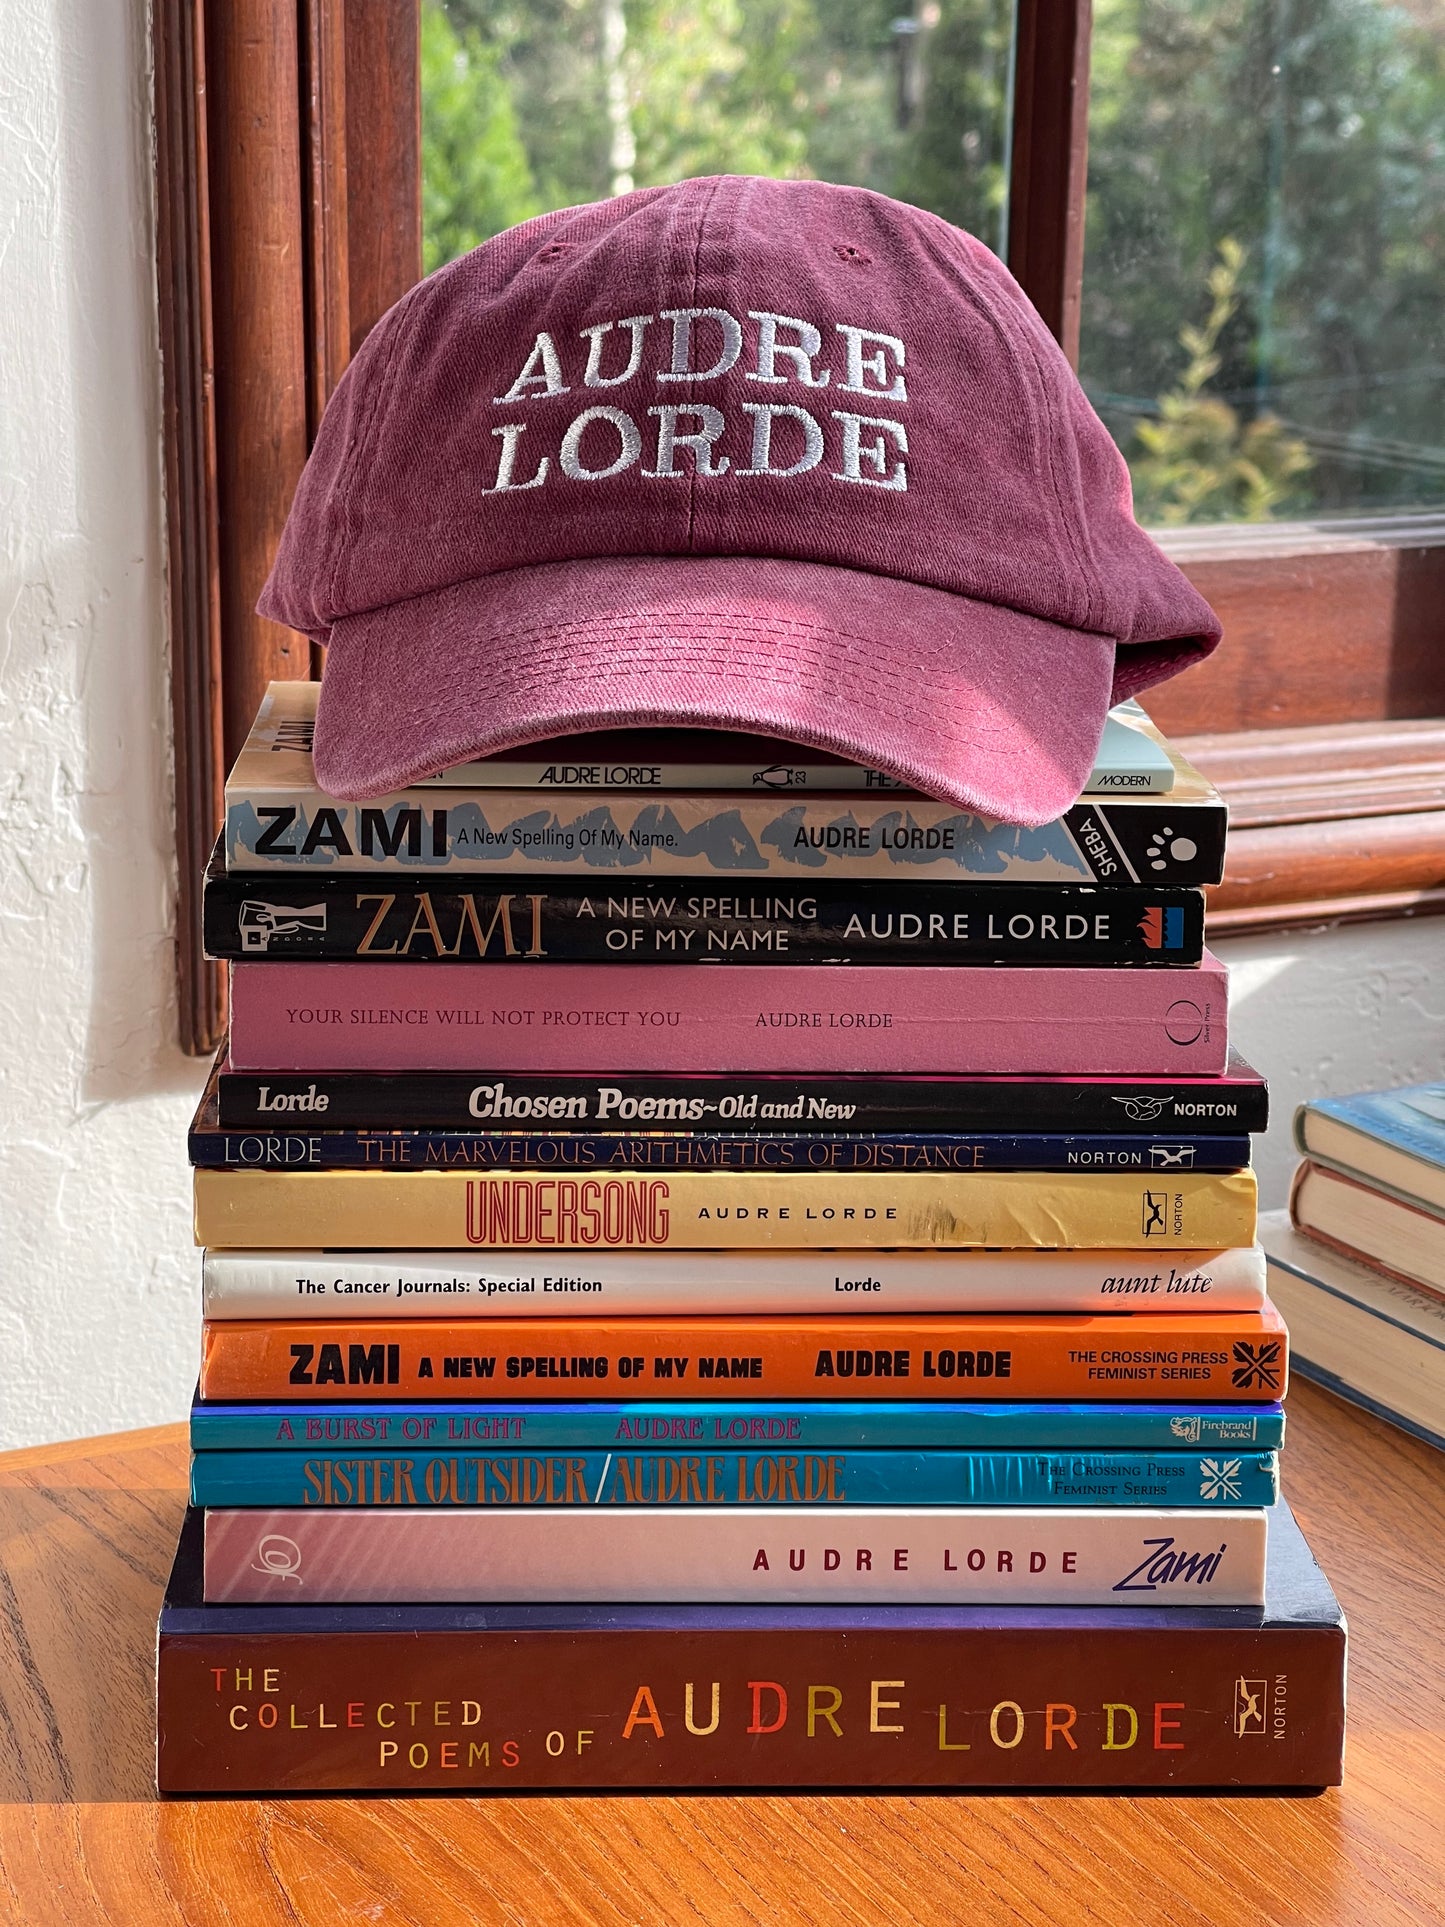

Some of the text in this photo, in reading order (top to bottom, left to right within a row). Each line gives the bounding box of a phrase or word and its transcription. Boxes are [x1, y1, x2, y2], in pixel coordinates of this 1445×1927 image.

[493, 306, 907, 402] AUDRE
[481, 403, 908, 496] LORDE
[538, 766, 661, 785] AUDRE LORDE
[1098, 775, 1151, 786] MODERN
[254, 807, 679, 857] ZAMI A New Spelling Of My Name.
[794, 826, 955, 850] AUDRE LORDE
[1079, 818, 1118, 876] SHEBA
[576, 897, 818, 919] A NEW SPELLING
[355, 892, 549, 956] ZAMI
[843, 913, 1111, 940] AUDRE LORDE
[606, 929, 789, 951] OF MY NAME
[286, 1009, 681, 1027] YOUR SILENCE WILL NOT PROTECT YOU
[755, 1012, 893, 1029] AUDRE LORDE
[1203, 1003, 1212, 1043] Silver Press
[257, 1084, 329, 1113] Lorde
[468, 1082, 589, 1120] Chosen
[761, 1095, 803, 1120] and
[807, 1098, 858, 1121] New
[1174, 1103, 1237, 1117] NORTON
[224, 1137, 322, 1163] LORDE
[357, 1139, 986, 1167] THE MARVELOUS ARITHMETICS OF DISTANCE
[1067, 1151, 1142, 1164] NORTON
[465, 1180, 670, 1244] UNDERSONG
[698, 1207, 898, 1219] AUDRE LORDE
[1174, 1193, 1183, 1236] NORTON
[296, 1277, 602, 1297] The Cancer Journals: Special Edition
[834, 1276, 882, 1293] Lorde
[1101, 1269, 1214, 1294] aunt lute
[289, 1344, 762, 1385] ZAMI A NEW SPELLING OF MY NAME
[814, 1350, 1011, 1378] AUDRE LORDE
[1068, 1351, 1228, 1364] THE CROSSING PRESS
[1088, 1367, 1211, 1380] FEMINIST SERIES
[276, 1417, 526, 1441] A BURST OF LIGHT
[615, 1417, 802, 1440] AUDRE LORDE
[1202, 1420, 1251, 1430] Firebrand
[1219, 1429, 1251, 1439] Books
[302, 1458, 417, 1504] SISTER
[737, 1456, 846, 1501] LORDE
[752, 1548, 1078, 1574] AUDRE LORDE
[1112, 1537, 1227, 1592] Zami
[210, 1668, 280, 1693] THE
[229, 1701, 482, 1730] COLLECTED
[621, 1680, 1185, 1751] AUDRE LORDE
[1274, 1674, 1288, 1740] NORTON
[380, 1730, 594, 1769] POEMS OF
